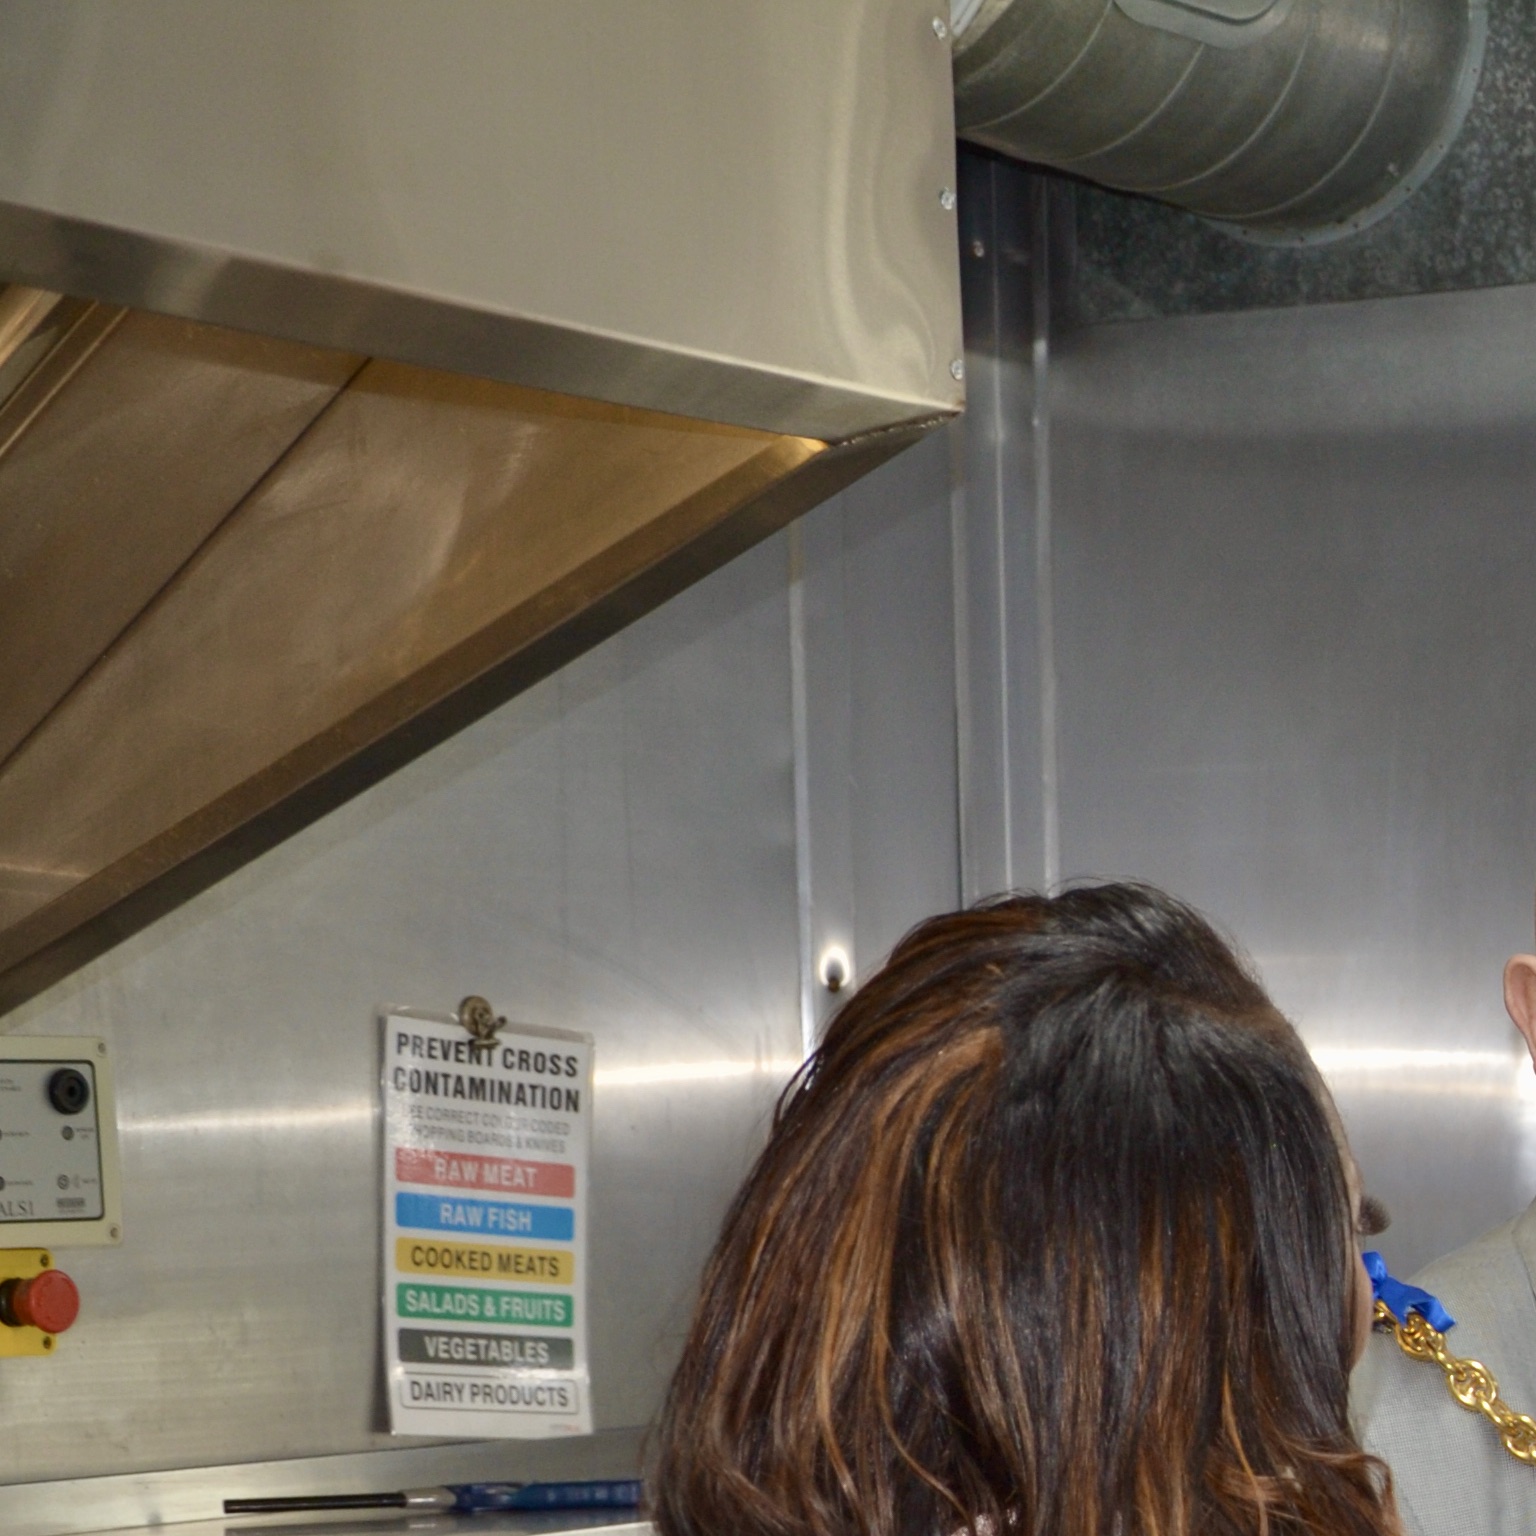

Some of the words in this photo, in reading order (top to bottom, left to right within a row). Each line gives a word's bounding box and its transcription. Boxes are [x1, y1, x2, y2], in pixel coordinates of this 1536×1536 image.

[397, 1032, 493, 1067] PREVENT
[502, 1047, 578, 1078] CROSS
[393, 1066, 580, 1114] CONTAMINATION
[434, 1158, 478, 1182] RAW
[484, 1163, 537, 1188] MEAT
[440, 1203, 484, 1228] RAW
[488, 1207, 532, 1232] FISH
[411, 1245, 492, 1272] COOKED
[498, 1252, 560, 1277] MEATS
[405, 1289, 481, 1316] SALADS
[484, 1296, 497, 1318] &
[501, 1297, 566, 1322] FRUITS
[424, 1336, 550, 1364] VEGETABLES
[410, 1380, 465, 1403] DAIRY
[471, 1383, 569, 1408] PRODUCTS
